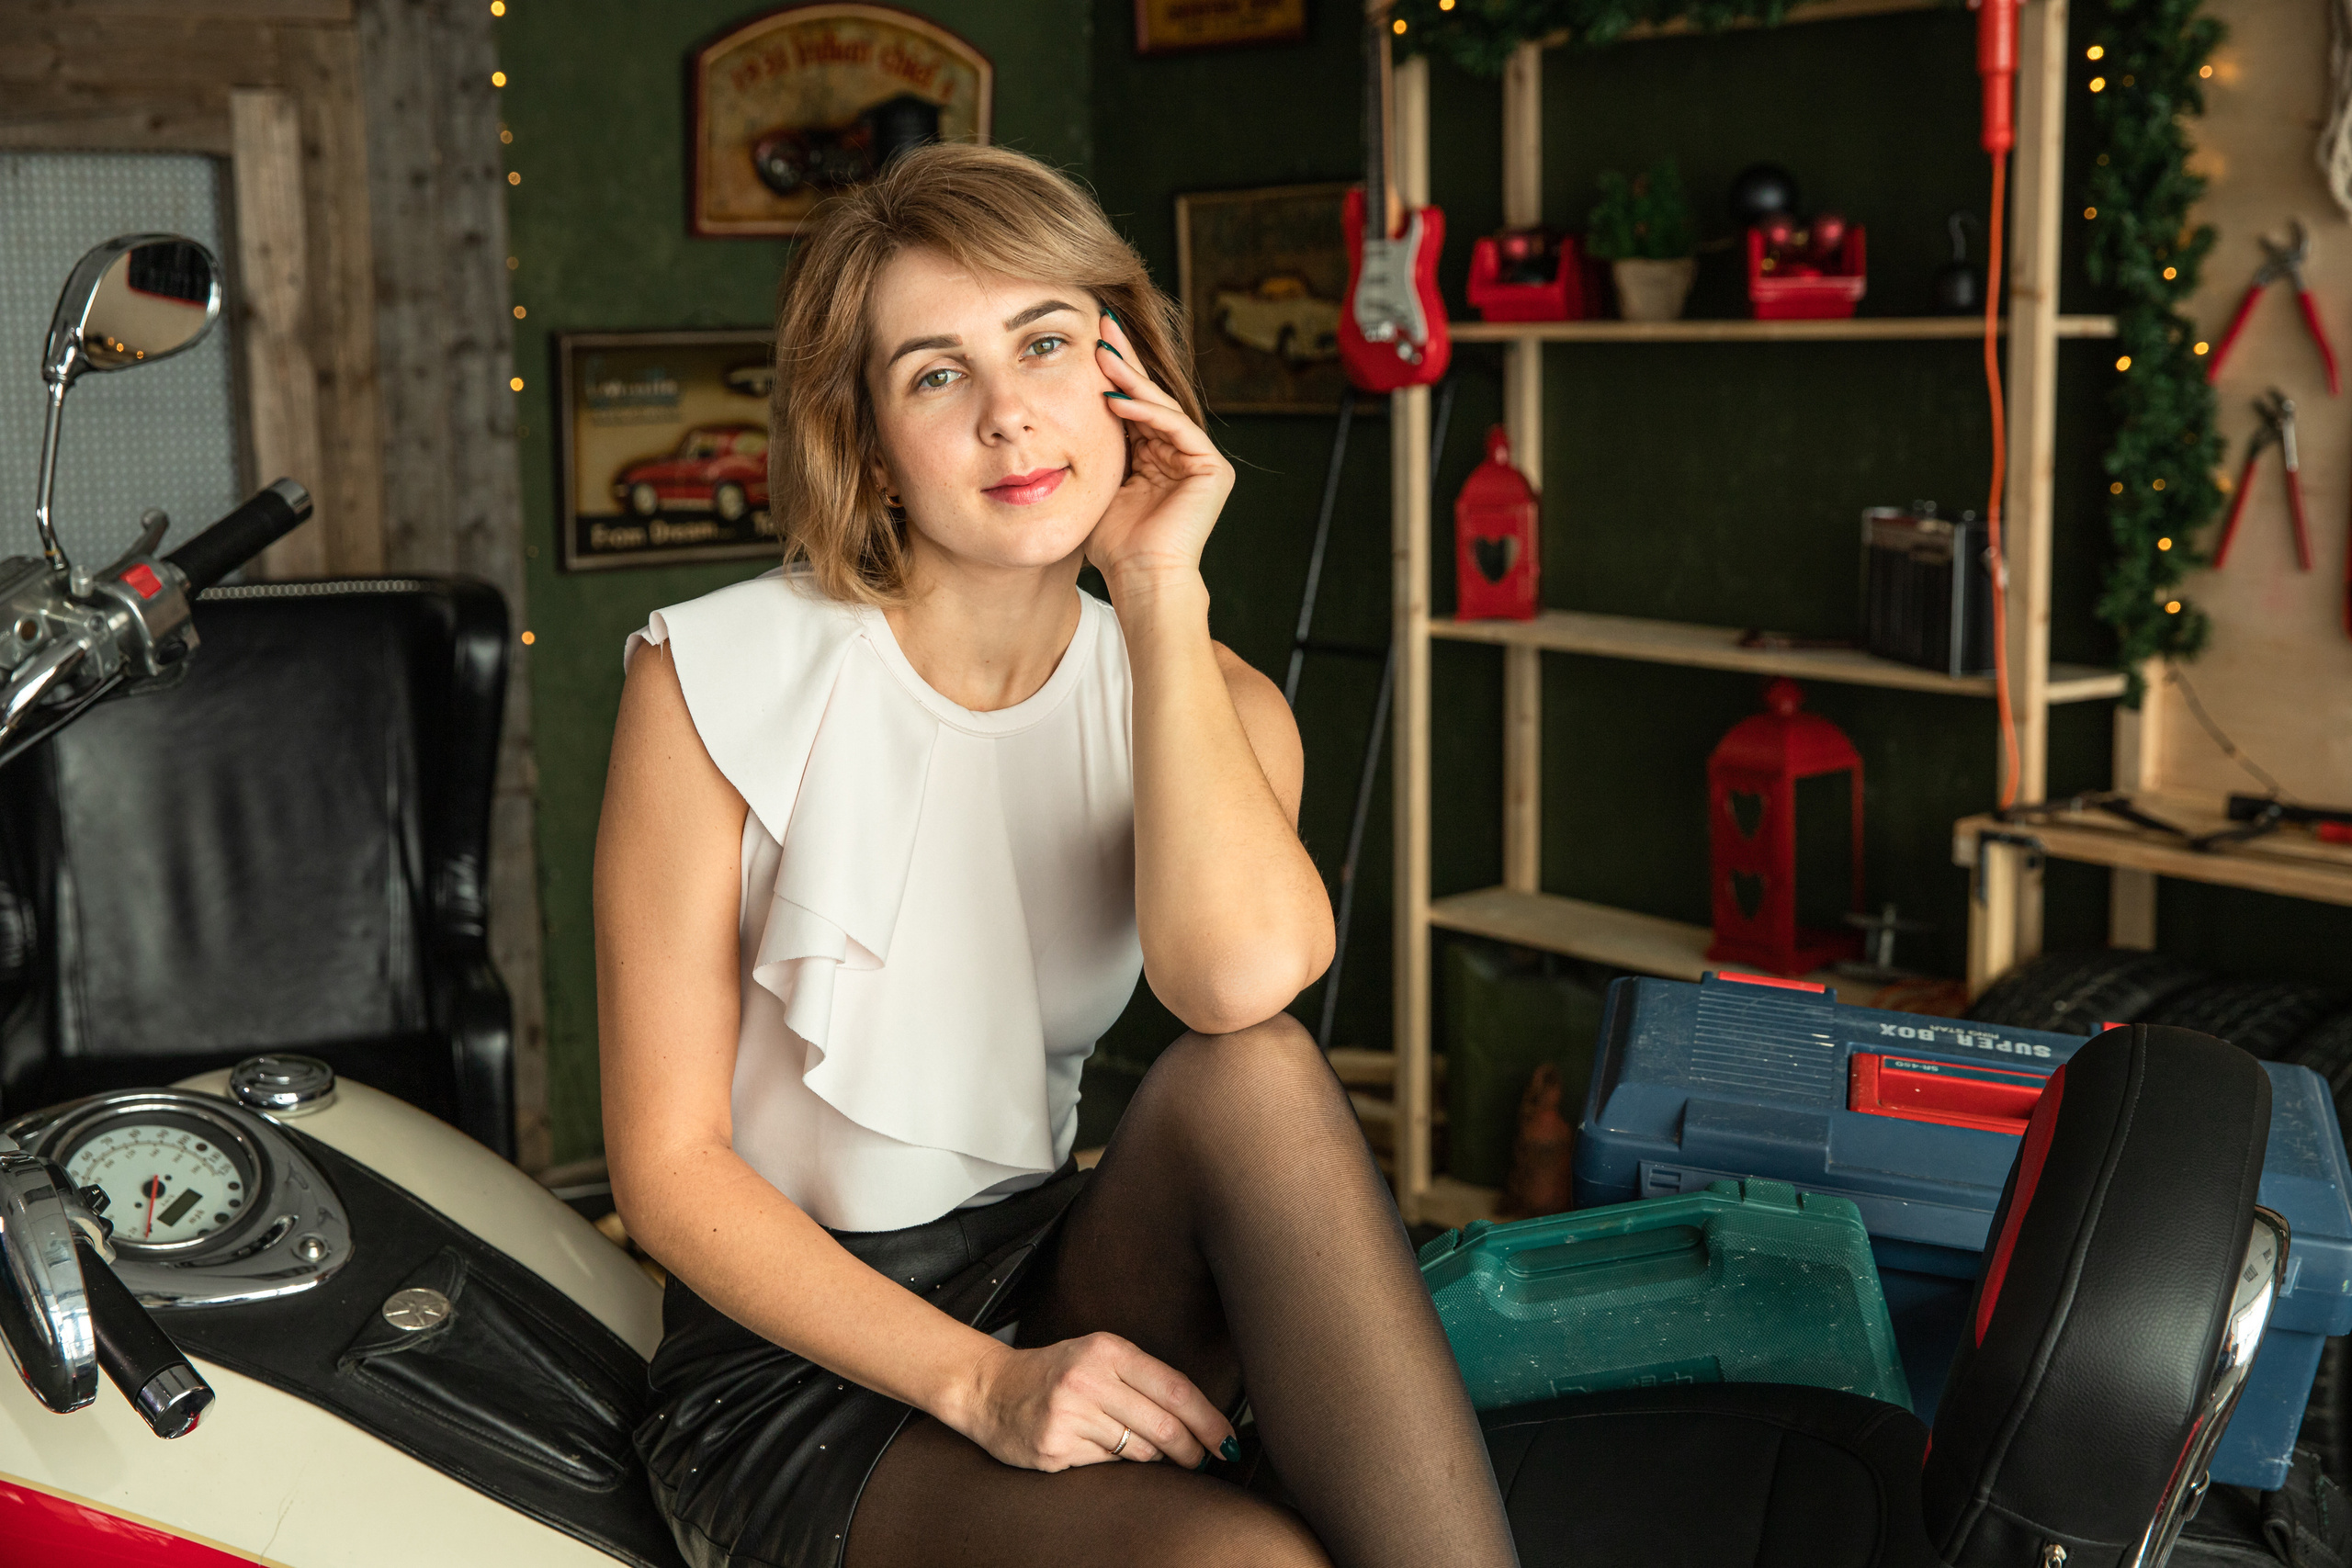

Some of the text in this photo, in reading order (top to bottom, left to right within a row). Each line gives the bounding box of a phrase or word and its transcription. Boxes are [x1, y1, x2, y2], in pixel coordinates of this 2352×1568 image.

[591, 523, 647, 550] From
[1929, 1024, 1965, 1034] STAR
[1879, 1022, 2052, 1058] SUPER BOX
[188, 1208, 205, 1224] mph
